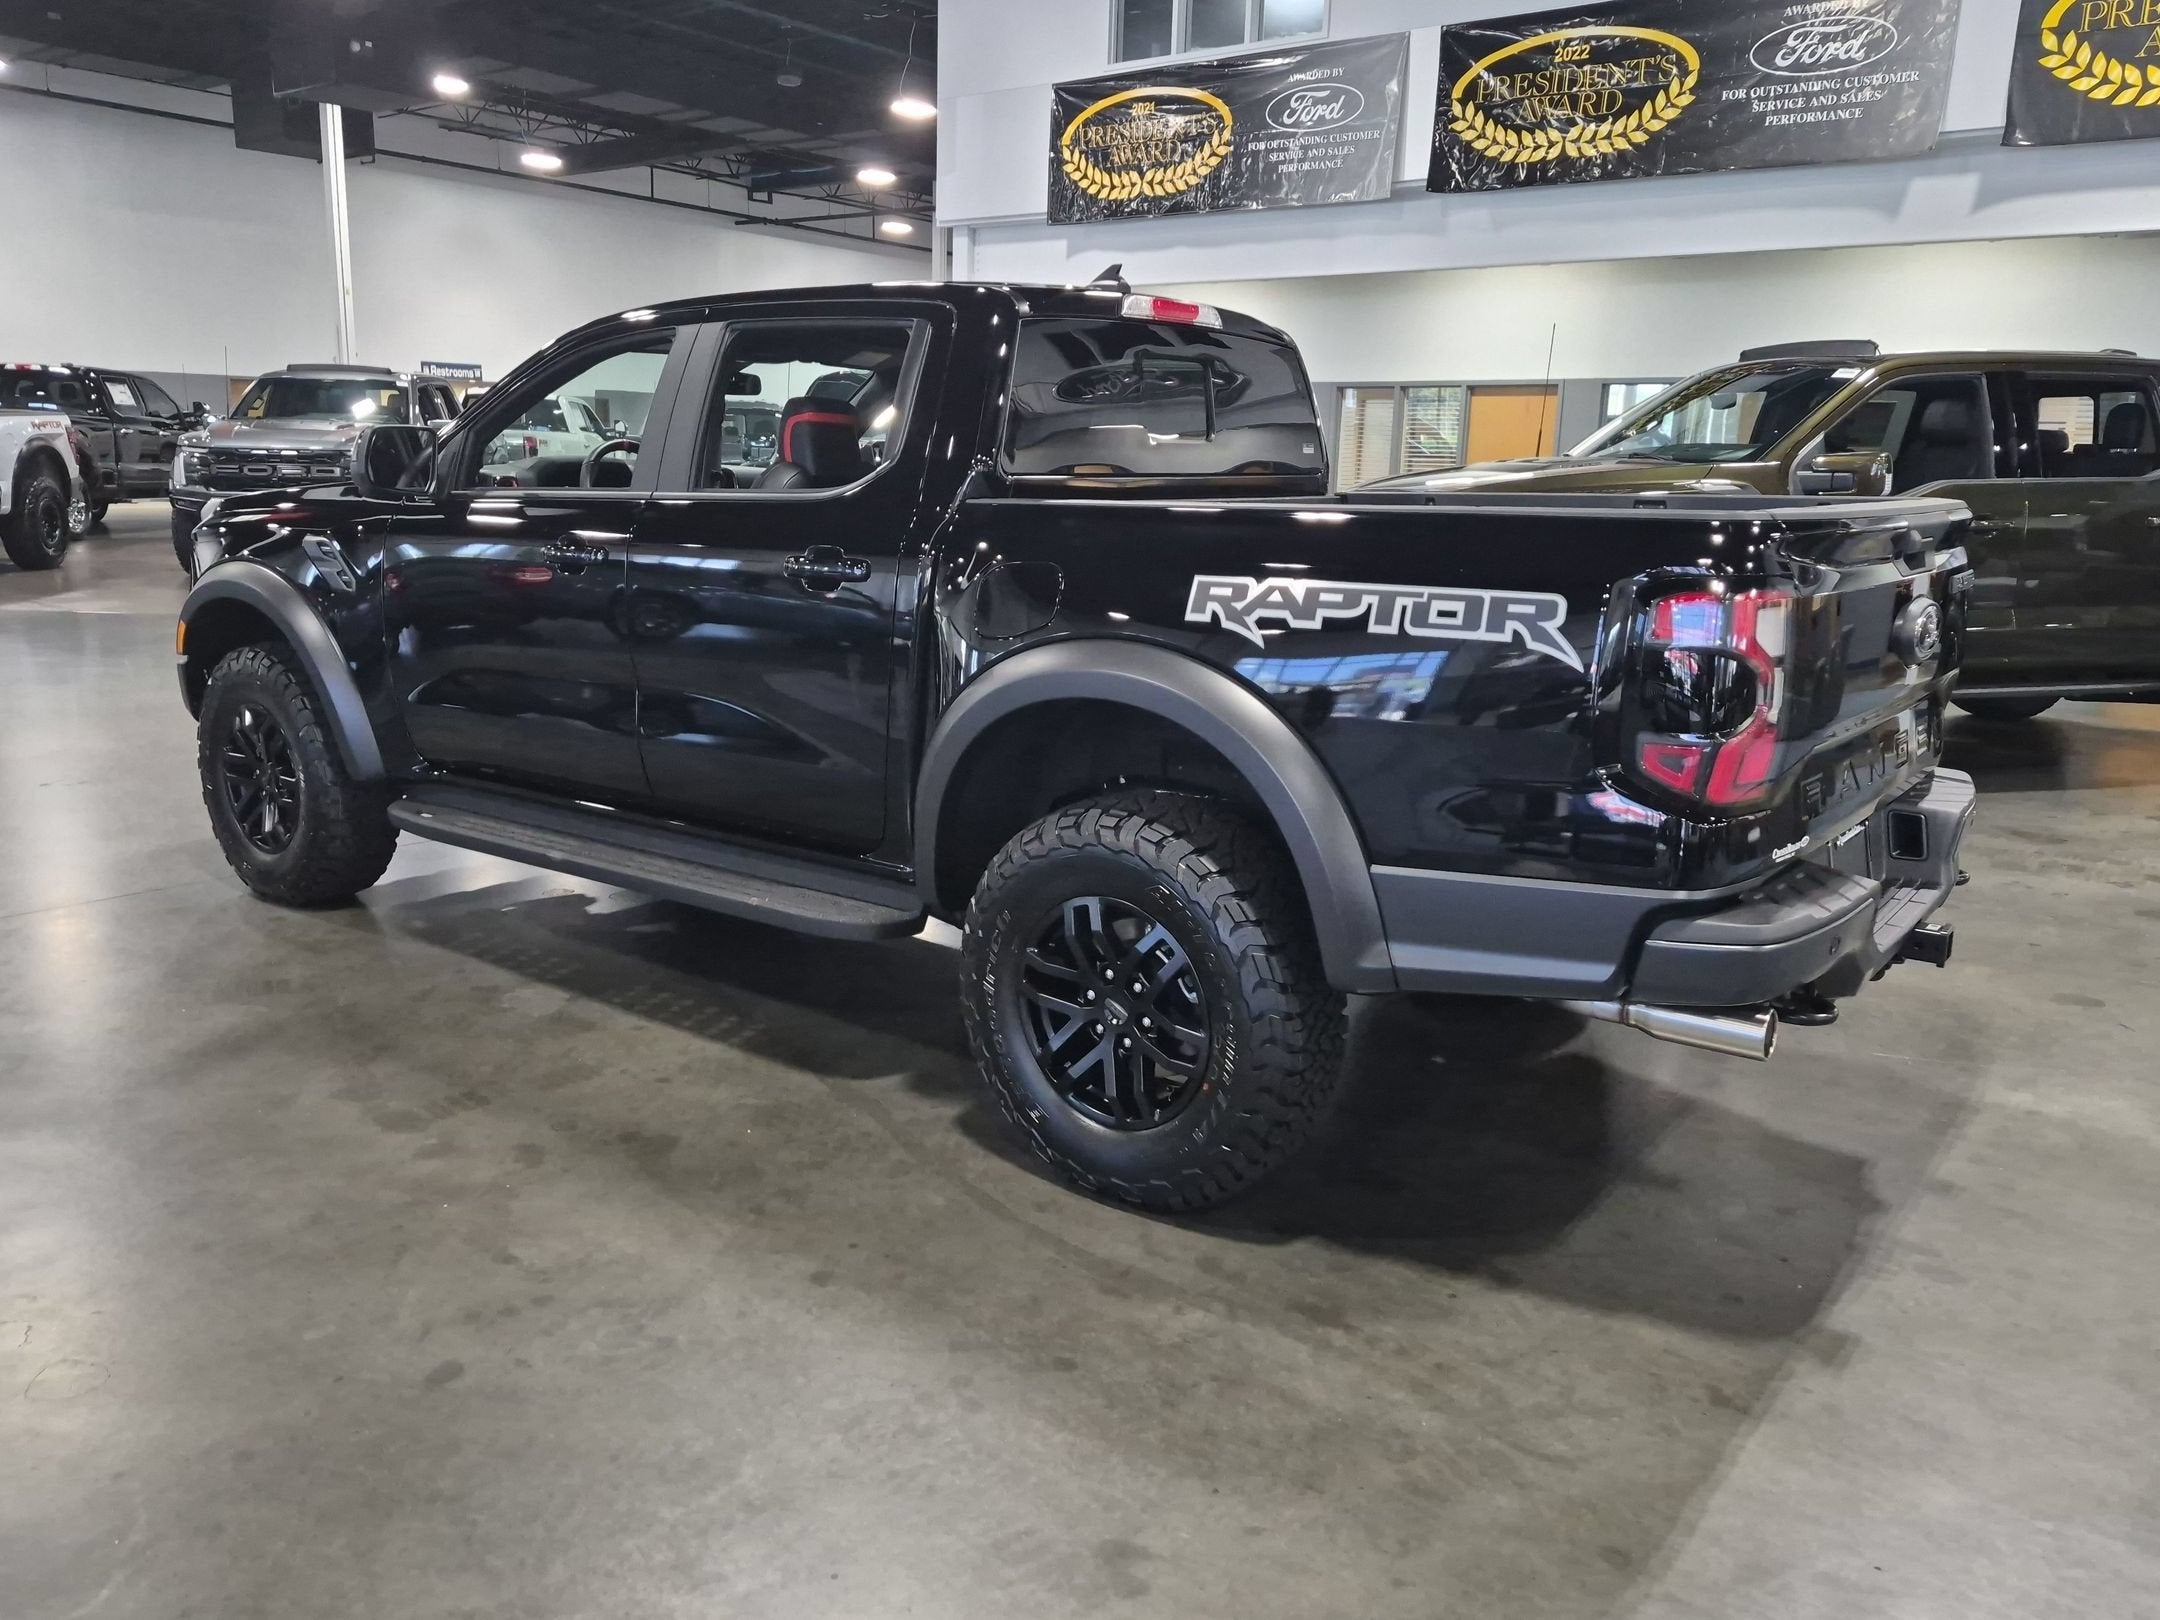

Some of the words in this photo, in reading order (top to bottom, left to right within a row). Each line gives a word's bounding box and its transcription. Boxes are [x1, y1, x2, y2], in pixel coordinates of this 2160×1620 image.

[1784, 0, 1849, 17] AWARD
[1554, 45, 1590, 63] 2022
[1775, 24, 1870, 68] Ford
[1288, 69, 1330, 82] AWARDED
[1332, 67, 1345, 77] BY
[1475, 54, 1677, 104] PRESIDENT'S
[1721, 88, 1747, 101] FOR
[1750, 78, 1841, 98] OUTSTANDING
[1844, 71, 1920, 89] CUSTOMER
[1132, 101, 1156, 115] 2021
[1283, 90, 1345, 124] Ford
[1514, 89, 1623, 125] AWARD
[1752, 97, 1806, 113] SERVICE
[1809, 94, 1837, 108] AND
[1840, 89, 1883, 104] SALES
[1764, 107, 1865, 127] PERFORMANCE
[1267, 133, 1328, 149] OUTSTANDING
[1330, 130, 1380, 142] CUSTOMER
[1106, 139, 1182, 167] AWARD
[1269, 150, 1305, 162] SERVICE
[1307, 148, 1326, 159] AND
[1327, 145, 1355, 156] SALES
[1278, 159, 1344, 173] PERFORMANCE
[430, 364, 474, 379] Restrooms
[1184, 574, 1584, 674] RAPTOR
